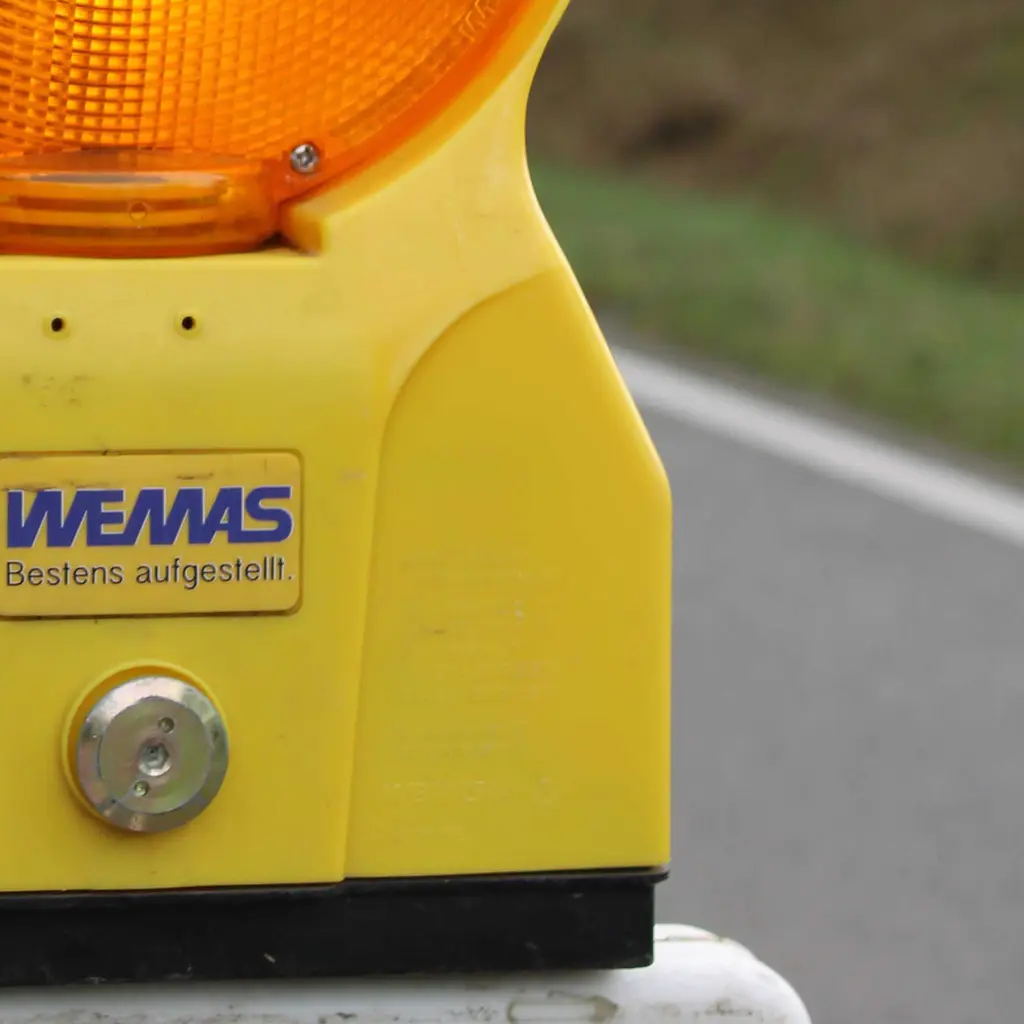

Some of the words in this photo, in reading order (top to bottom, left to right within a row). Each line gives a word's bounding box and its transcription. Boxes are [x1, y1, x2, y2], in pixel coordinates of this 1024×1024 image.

[7, 486, 292, 547] WEMAS
[6, 561, 123, 586] Bestens
[136, 556, 293, 589] aufgestellt.
